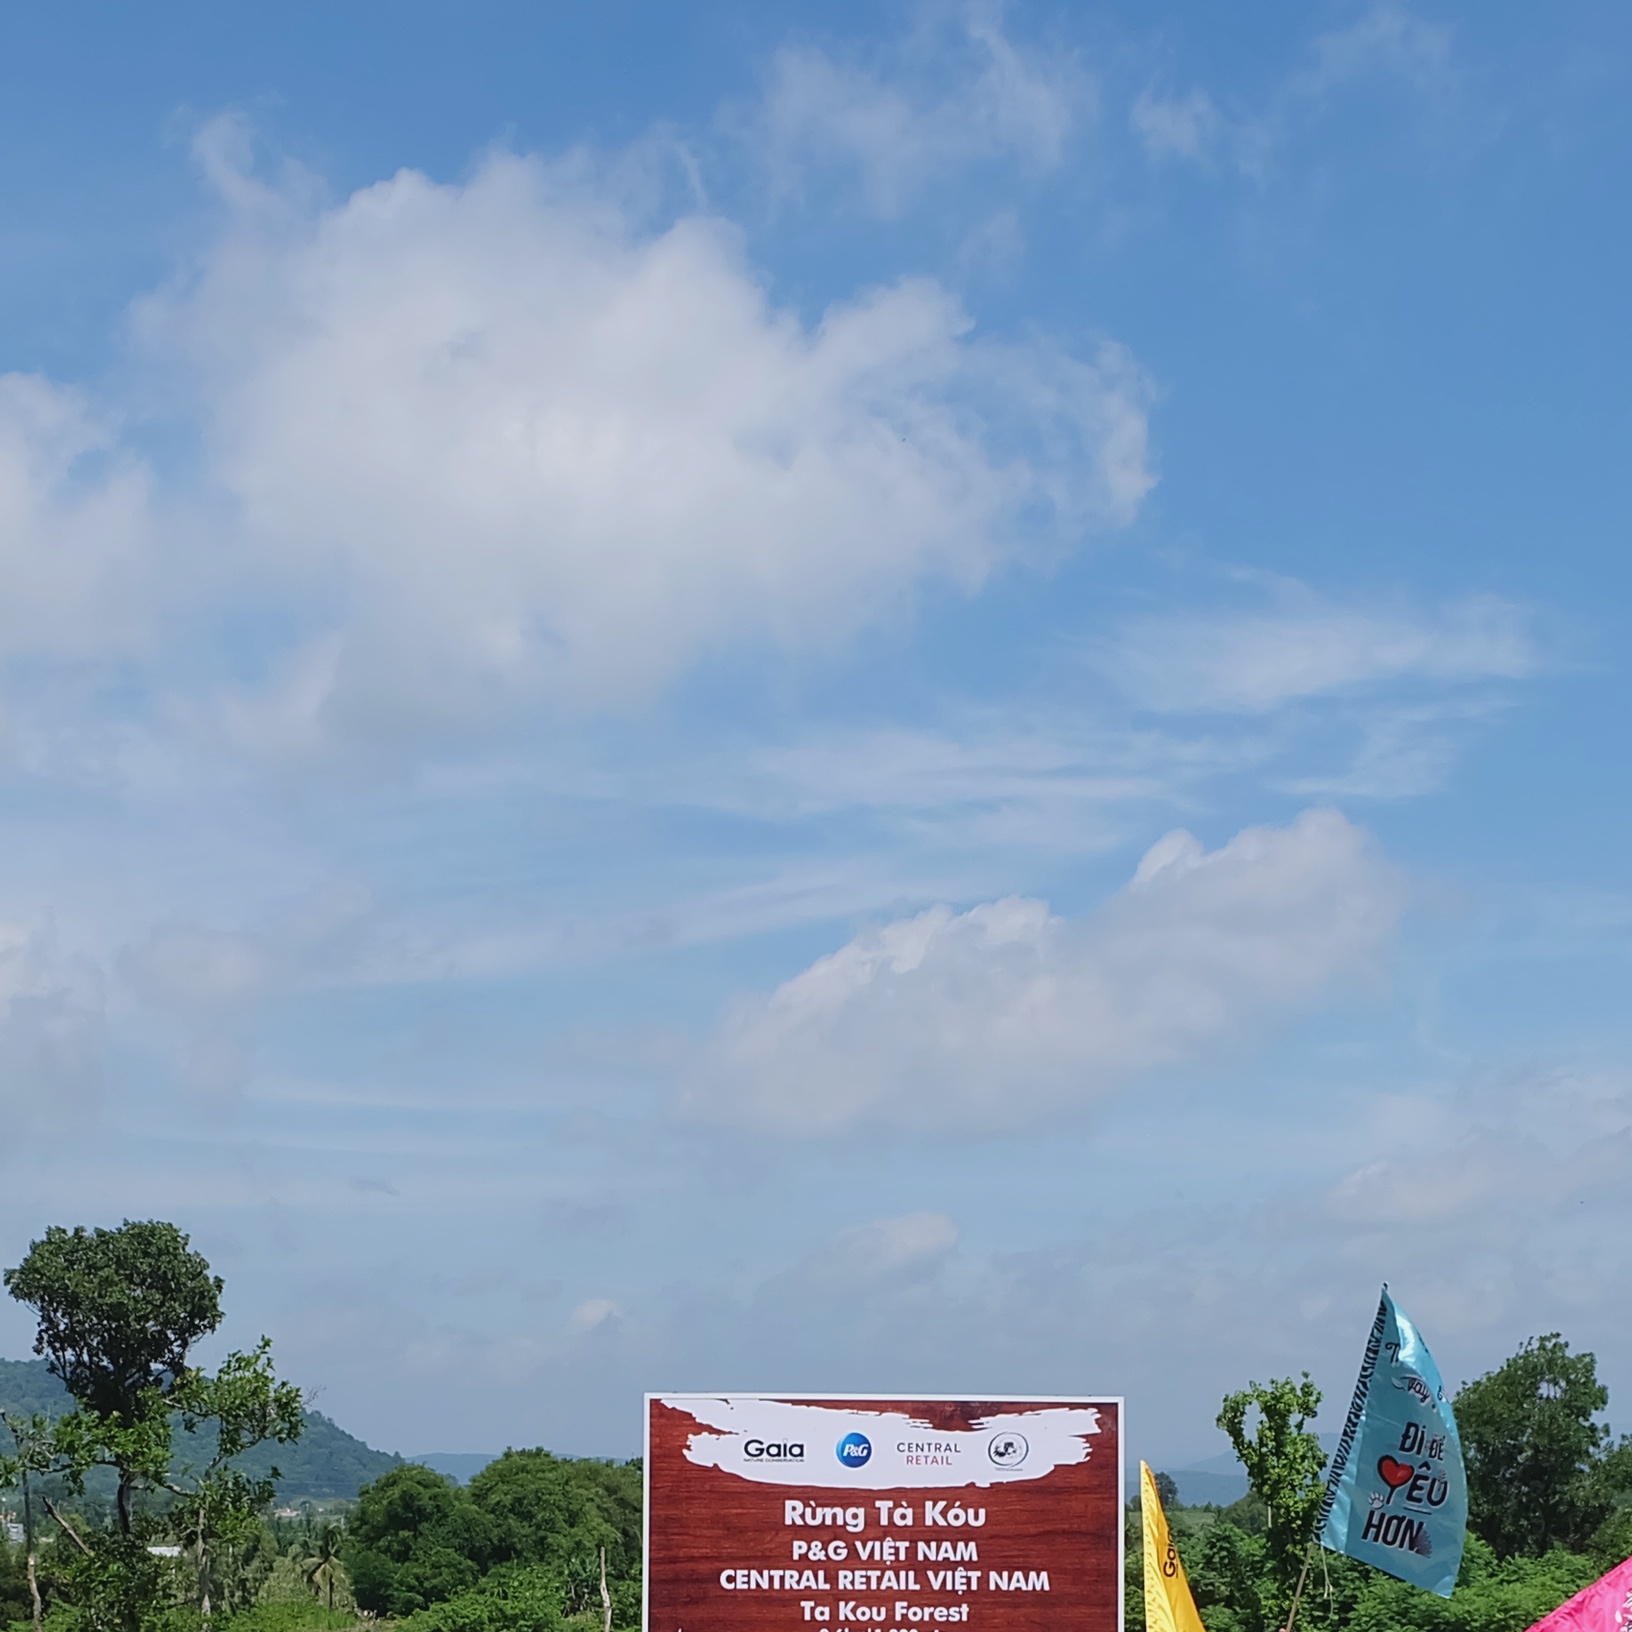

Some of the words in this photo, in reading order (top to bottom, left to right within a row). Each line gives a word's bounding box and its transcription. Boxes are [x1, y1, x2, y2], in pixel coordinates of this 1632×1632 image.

[744, 1439, 804, 1458] Gaia
[843, 1444, 868, 1457] P&G
[897, 1442, 961, 1453] CENTRAL
[906, 1455, 952, 1465] RETAIL
[785, 1500, 864, 1533] Rừng
[876, 1500, 913, 1527] Tà
[925, 1500, 986, 1528] Kóu
[1361, 1510, 1424, 1551] HƠN
[793, 1541, 848, 1561] P&G
[855, 1537, 909, 1565] VIỆT
[917, 1541, 978, 1561] NAM
[720, 1569, 830, 1590] CENTRAL
[838, 1570, 920, 1590] RETAIL
[927, 1567, 981, 1595] VIỆT
[990, 1571, 1050, 1591] NAM
[801, 1601, 830, 1621] Ta
[839, 1601, 886, 1622] Kou
[895, 1601, 969, 1622] Forest
